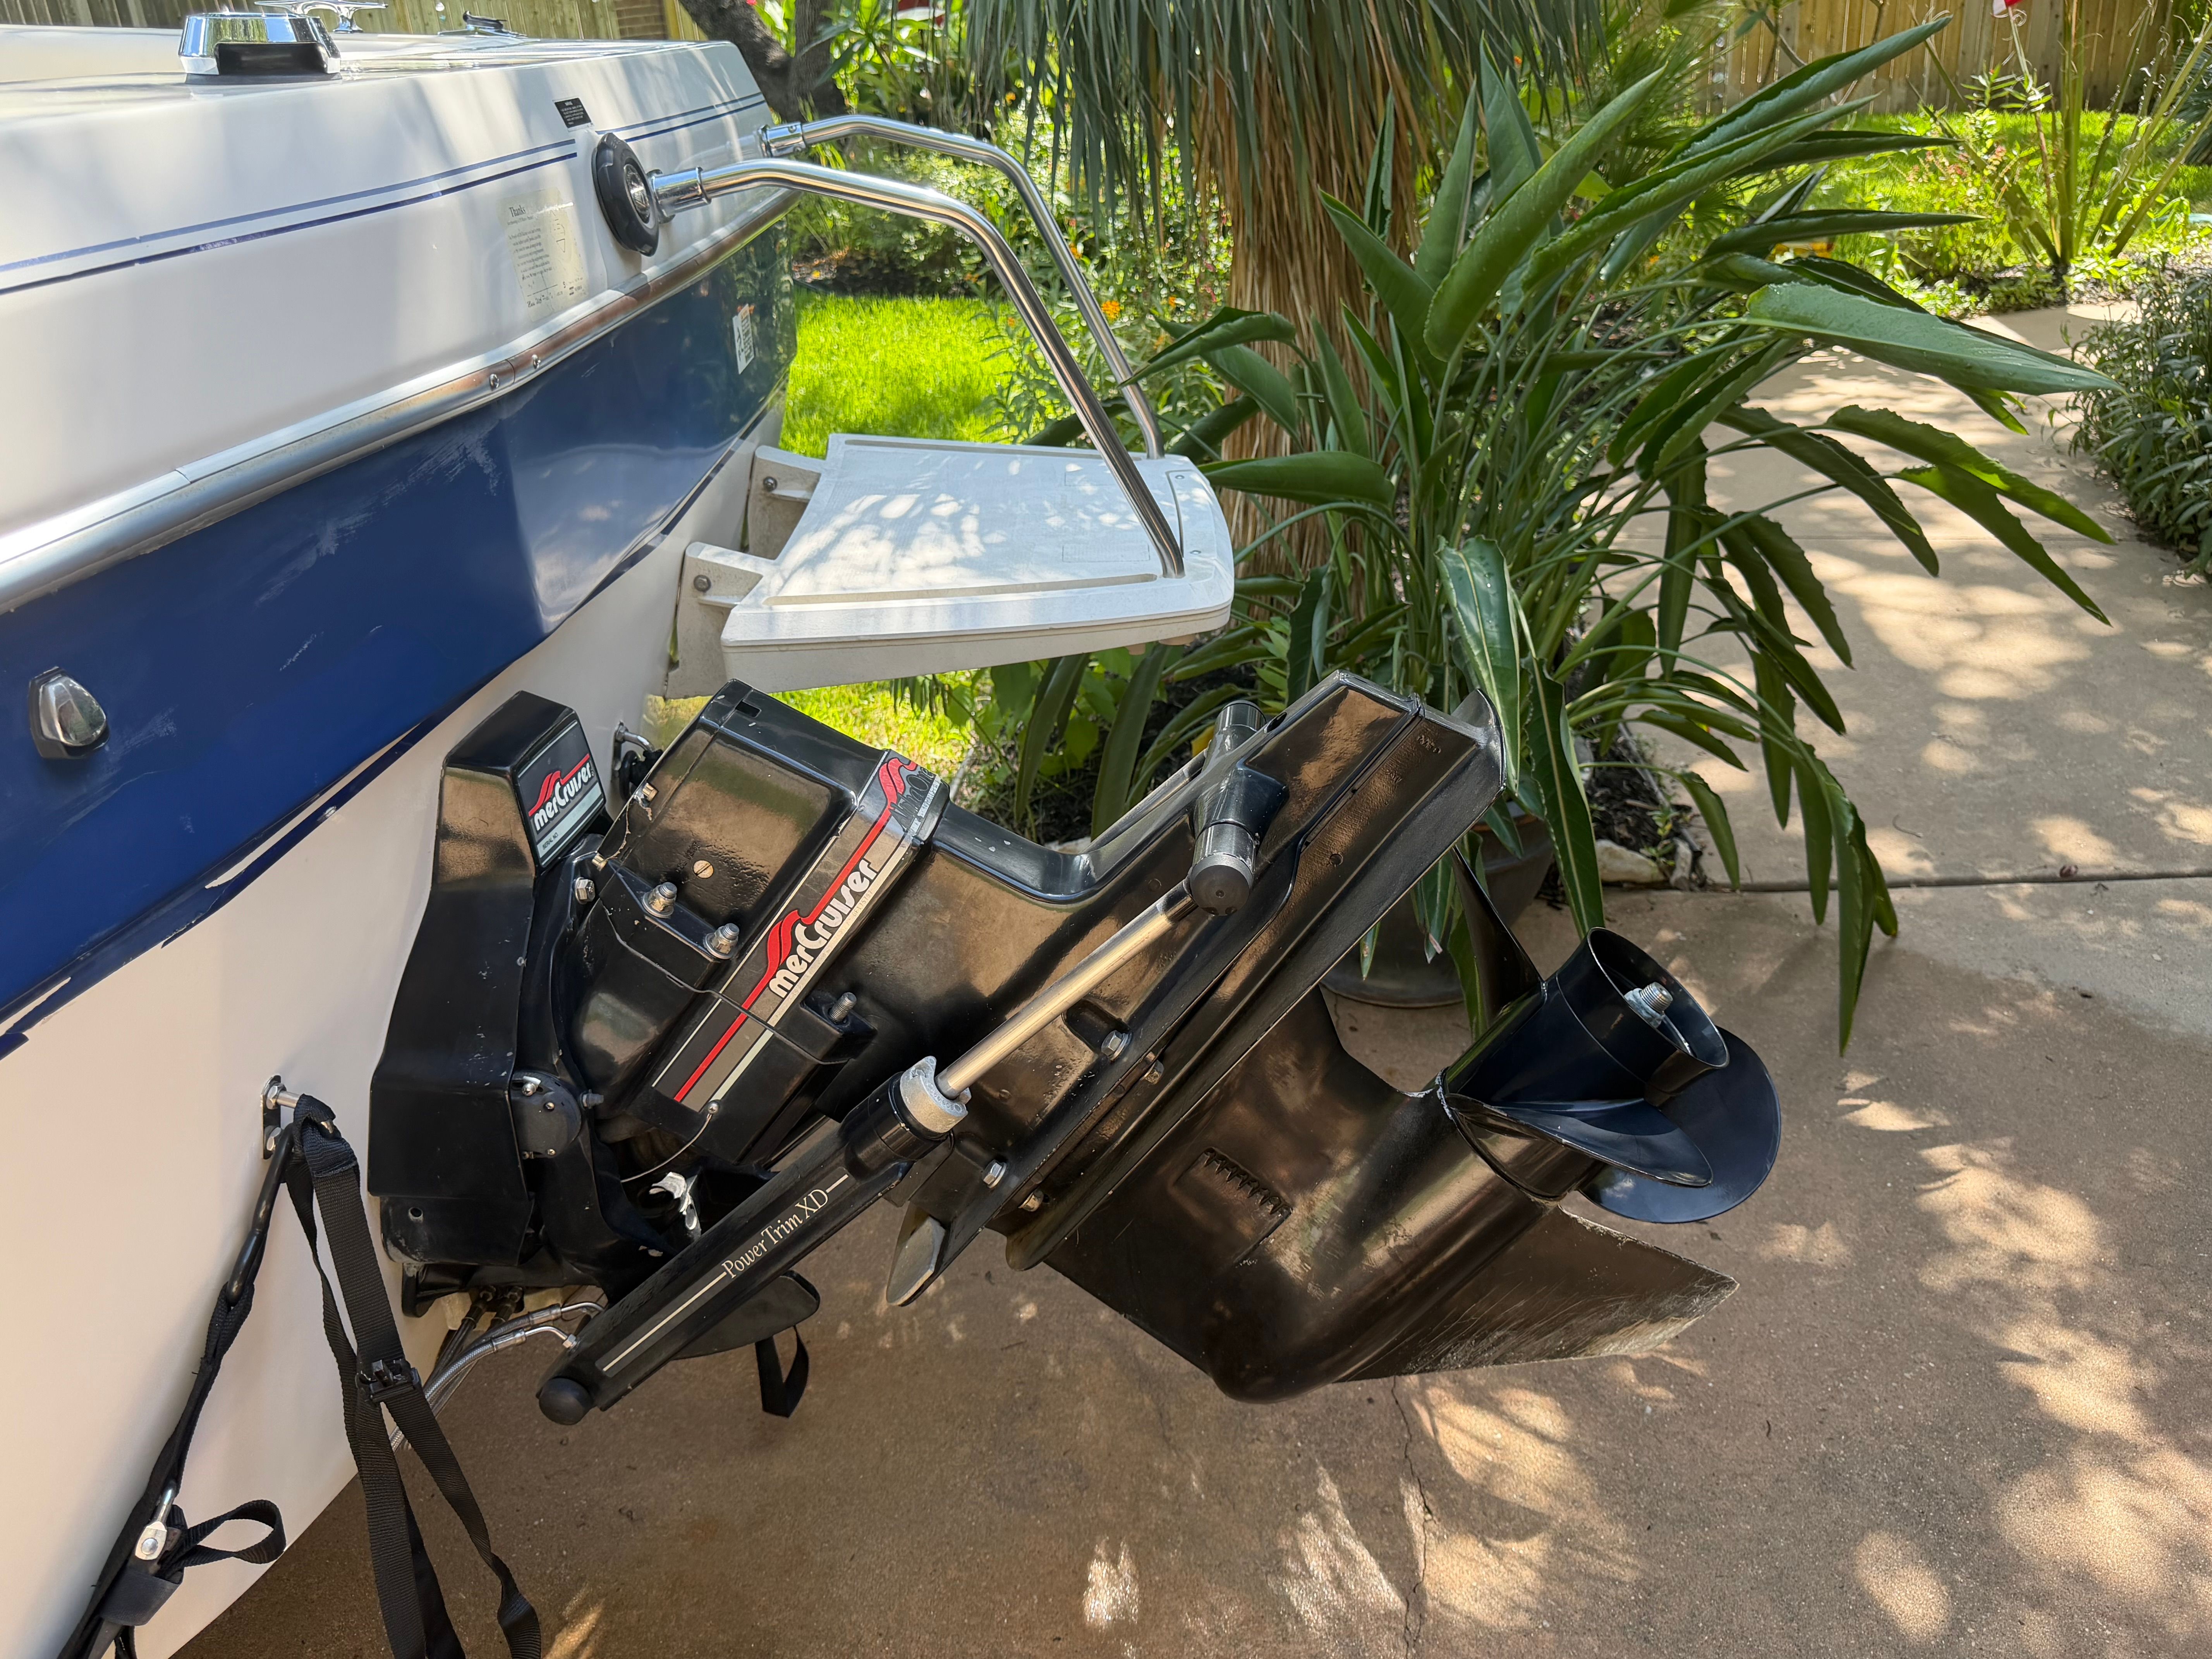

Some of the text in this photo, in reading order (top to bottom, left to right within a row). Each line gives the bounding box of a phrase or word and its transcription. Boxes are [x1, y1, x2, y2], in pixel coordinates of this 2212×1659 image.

[508, 204, 526, 217] Thanks
[533, 762, 592, 831] merCruiser
[542, 837, 553, 850] SERIAL
[769, 859, 879, 998] merCruiser
[721, 1189, 829, 1279] Power Trim XD
